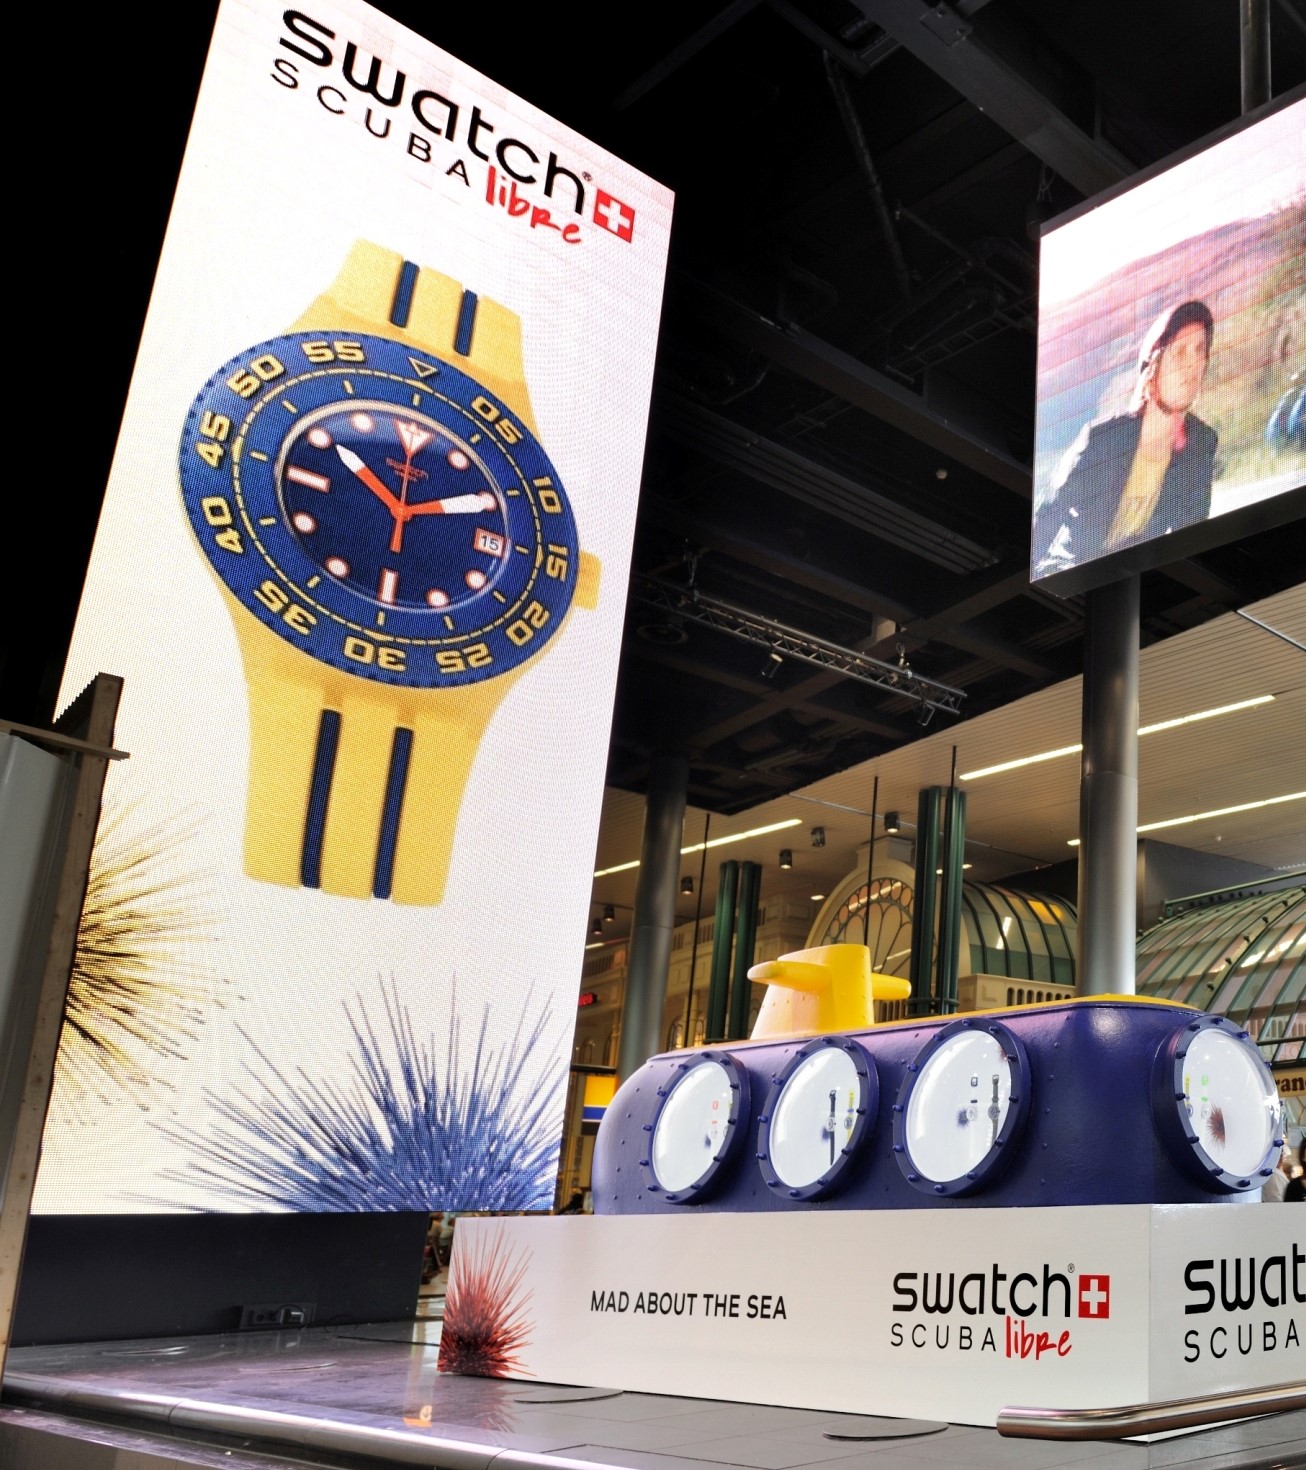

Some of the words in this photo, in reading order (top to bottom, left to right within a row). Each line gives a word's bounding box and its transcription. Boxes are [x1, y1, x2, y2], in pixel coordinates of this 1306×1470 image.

[270, 58, 471, 187] SCUBA
[302, 340, 365, 363] 55
[226, 354, 285, 397] 50
[195, 411, 232, 468] 45
[471, 395, 523, 444] 05
[533, 476, 562, 514] 10
[201, 496, 243, 554] 40
[481, 535, 499, 551] 15
[546, 543, 569, 581] 15
[253, 580, 317, 635] 35
[506, 600, 550, 646] 20
[344, 636, 407, 672] 30
[435, 643, 494, 673] 25
[590, 1290, 629, 1312] MAD
[633, 1291, 697, 1315] ABOUT
[702, 1293, 740, 1318] THE
[746, 1294, 787, 1320] SEA
[890, 1322, 997, 1352] SCUBA
[1183, 1318, 1300, 1363] SCUBA
